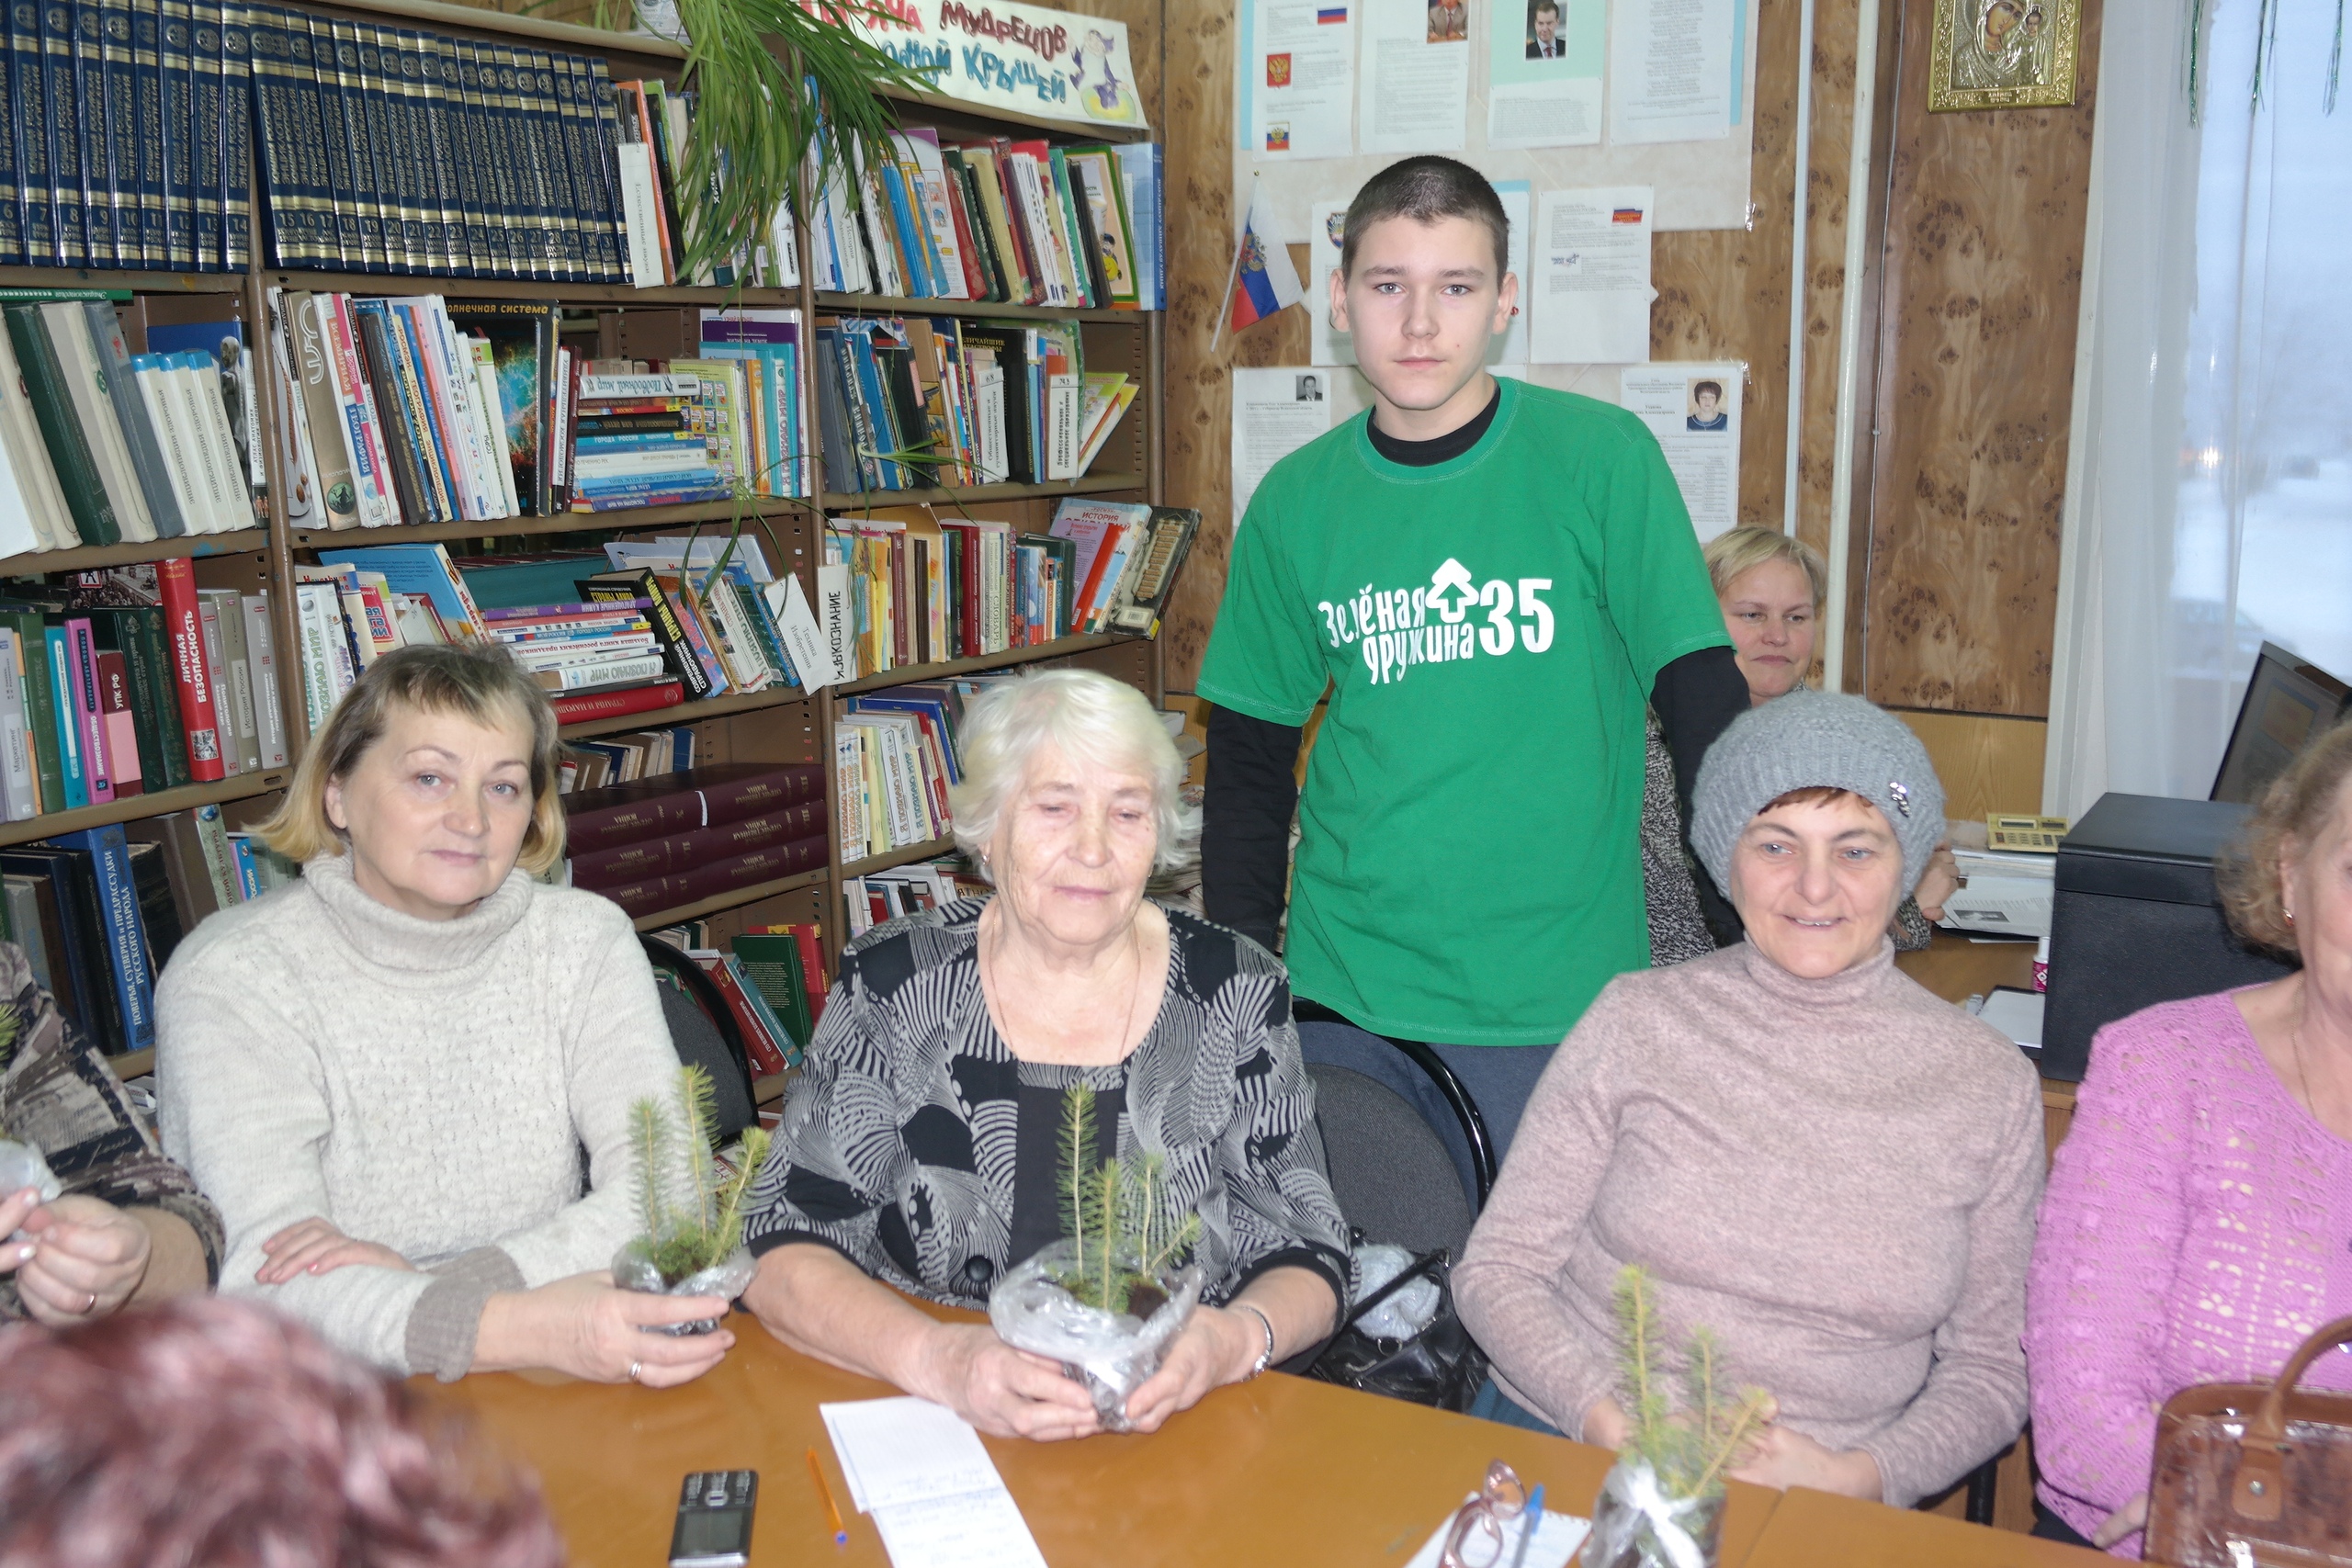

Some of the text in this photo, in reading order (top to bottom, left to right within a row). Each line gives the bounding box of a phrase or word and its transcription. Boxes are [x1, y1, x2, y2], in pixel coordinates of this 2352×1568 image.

[939, 0, 1067, 62] МУДРЕЦОВ
[963, 42, 1066, 103] КРЫШЕЙ
[446, 303, 548, 314] олнечная система
[962, 337, 1005, 345] ЛИЧАЙШИЕ
[158, 389, 196, 505] ЭНЦИКЛОПЕДИЯ ЗДОРОВЬЯ
[186, 389, 221, 503] ЭНЦИКЛОПЕДИЯ ЗДОРОВЬЯ
[209, 388, 242, 502] ЭНЦИКЛОПЕДИЯ ЗДОРОВЬЯ
[350, 408, 371, 474] ГЕОГРАФИЯ
[1082, 512, 1119, 522] ИСТОРИЯ
[645, 575, 682, 642] СТРАНЫ МИРА
[1317, 582, 1426, 649] Зелёная
[1478, 578, 1555, 656] 35
[175, 634, 192, 683] ЛИЧНАЯ
[185, 610, 207, 703] БЕЗОПАСНОСТЬ
[673, 644, 701, 694] СОВРЕМЕННЫЙ
[679, 638, 707, 689] СПРАВОЧНИК
[790, 625, 812, 670] Изобретения
[803, 627, 817, 657] Техника
[1363, 623, 1475, 685] дружина
[110, 673, 123, 709] УПК РФ
[238, 667, 251, 729] История России
[10, 728, 20, 773] Маркетинг
[90, 716, 105, 775] ОБЩЕСТВОЗНАНИЕ
[104, 851, 123, 928] ПРЕДРАССУДКИ
[118, 934, 134, 983] СУЕВЕРИЯ
[121, 886, 145, 985] РУССКОГО НАРОДА
